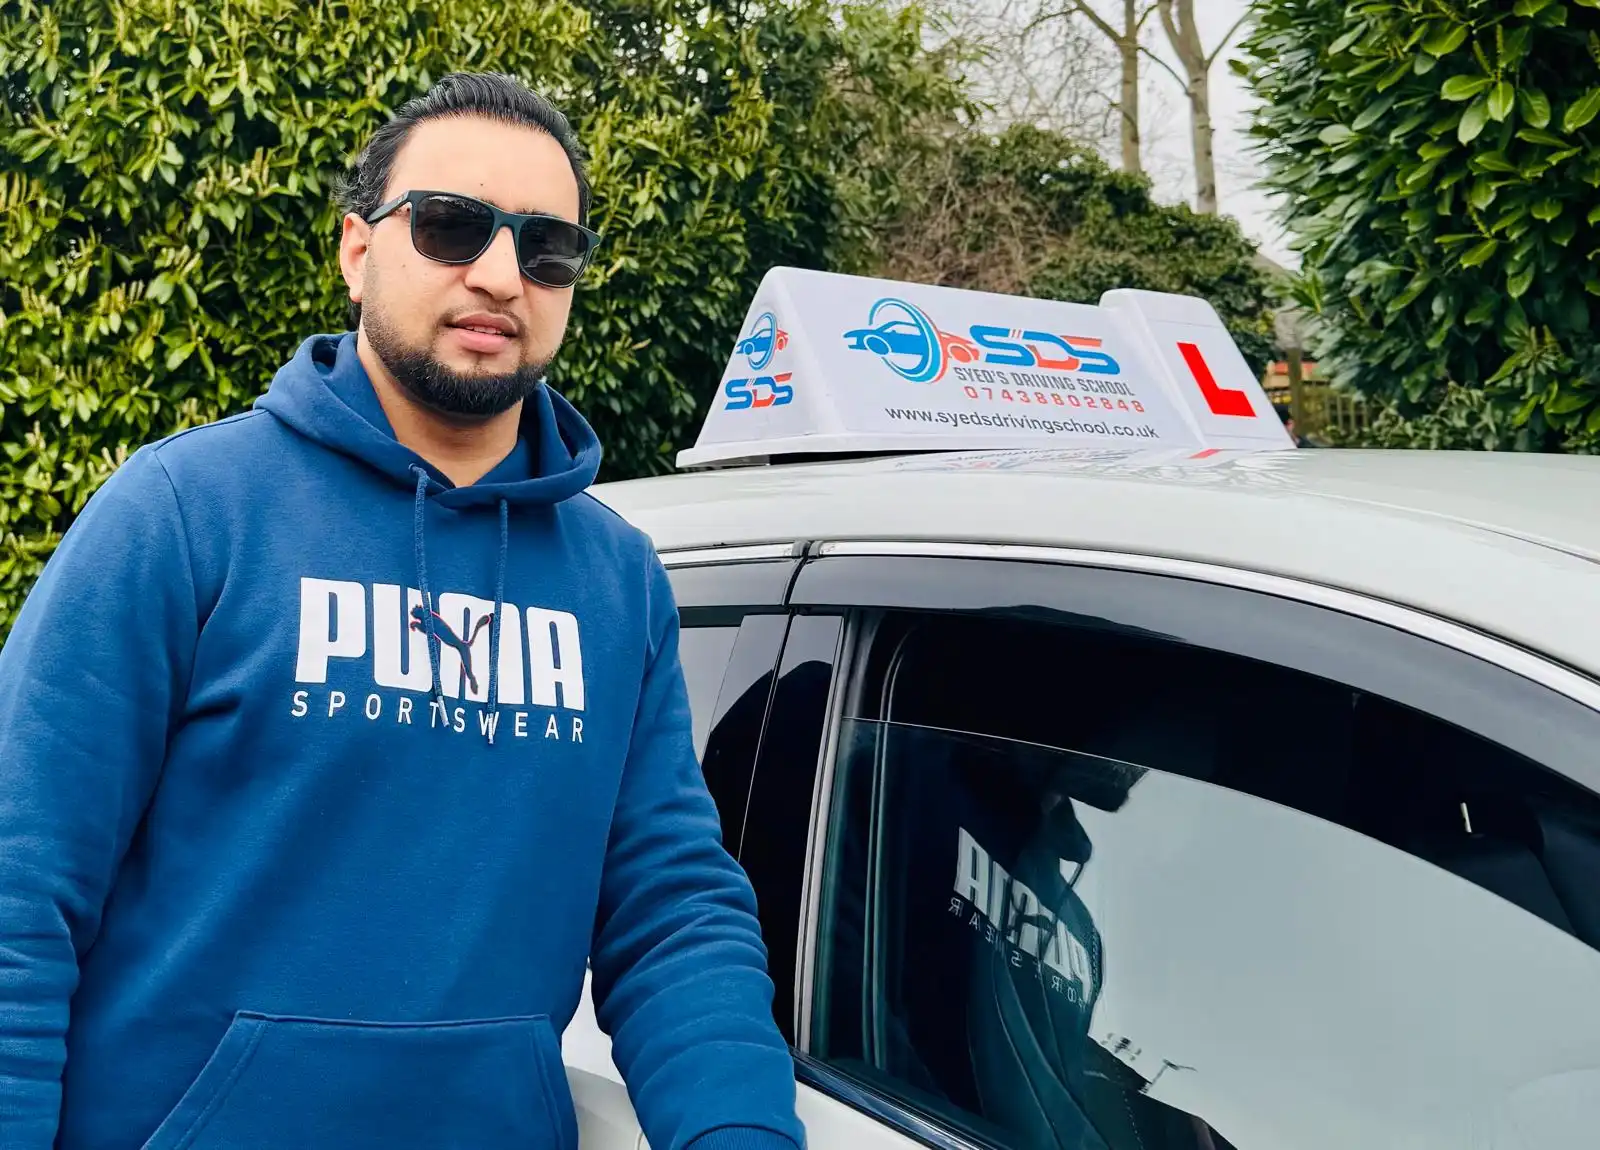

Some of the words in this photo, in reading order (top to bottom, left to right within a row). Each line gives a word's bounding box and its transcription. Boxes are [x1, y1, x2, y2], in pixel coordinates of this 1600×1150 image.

[969, 325, 1121, 375] SDS
[725, 372, 793, 410] SDS
[953, 367, 1009, 386] SYED'S
[1011, 372, 1076, 392] DRIVING
[1076, 378, 1135, 397] SCHOOL
[963, 386, 1145, 413] 07438802848
[1176, 342, 1257, 418] L
[885, 407, 1160, 439] www.syedsdrivingschool.co.uk
[295, 577, 585, 711] PUMA
[291, 690, 584, 744] SPORTSWEAR
